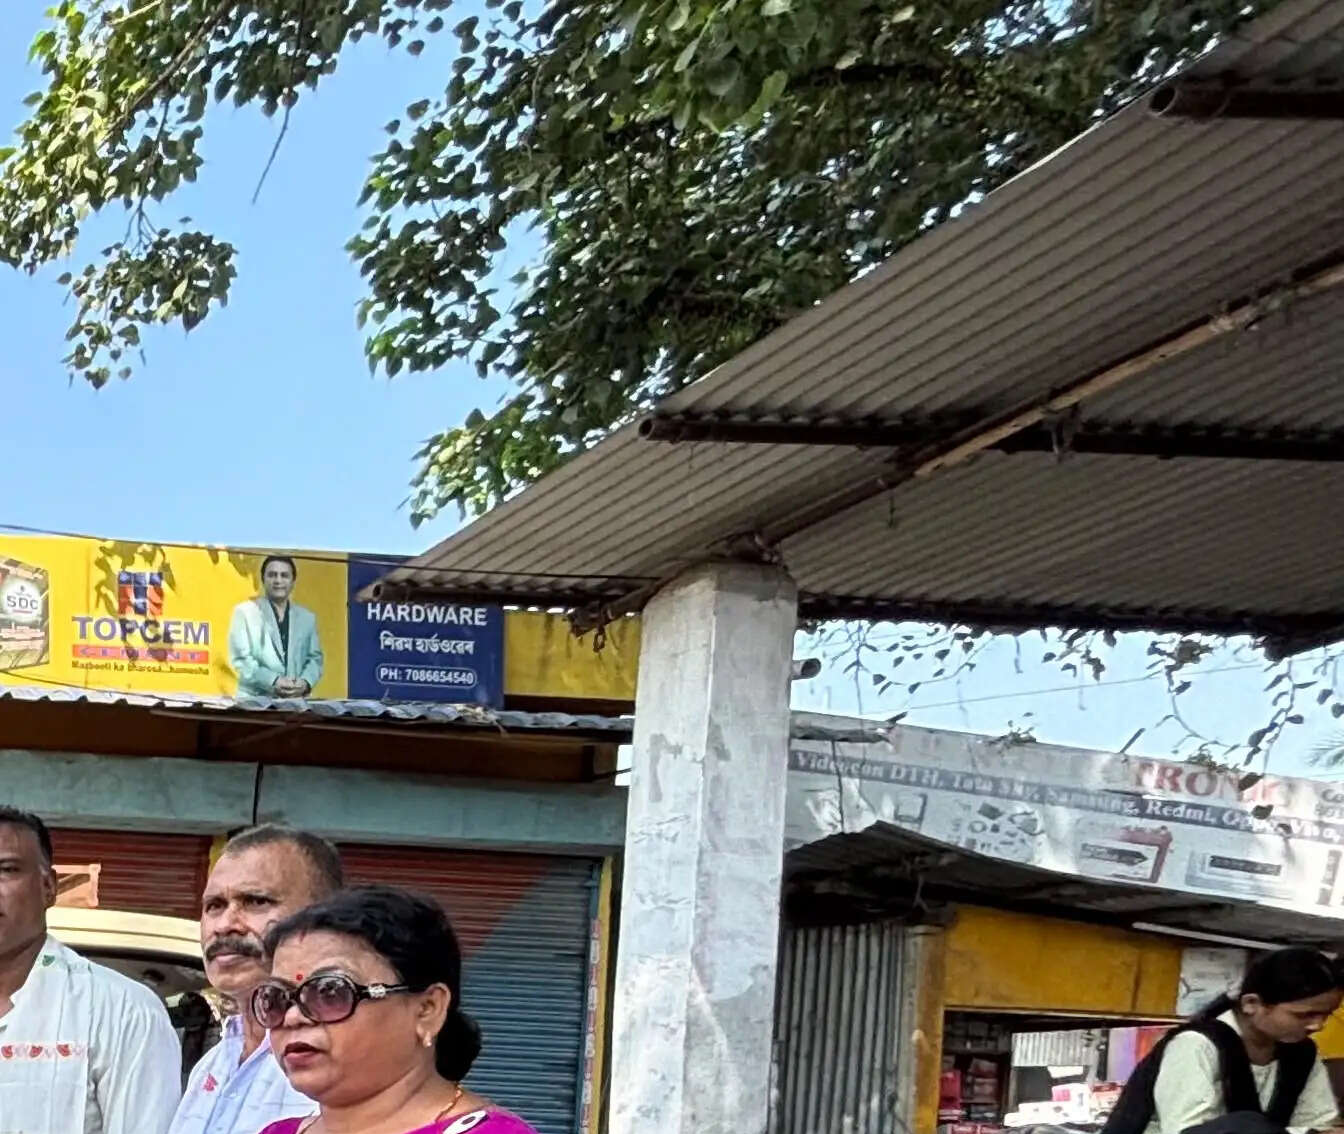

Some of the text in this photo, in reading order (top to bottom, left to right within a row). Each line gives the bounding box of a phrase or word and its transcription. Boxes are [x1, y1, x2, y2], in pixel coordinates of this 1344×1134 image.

[367, 602, 488, 626] HARDWARE
[71, 616, 210, 645] TOPCEM
[80, 647, 197, 660] CEMNT
[379, 667, 403, 680] PH:
